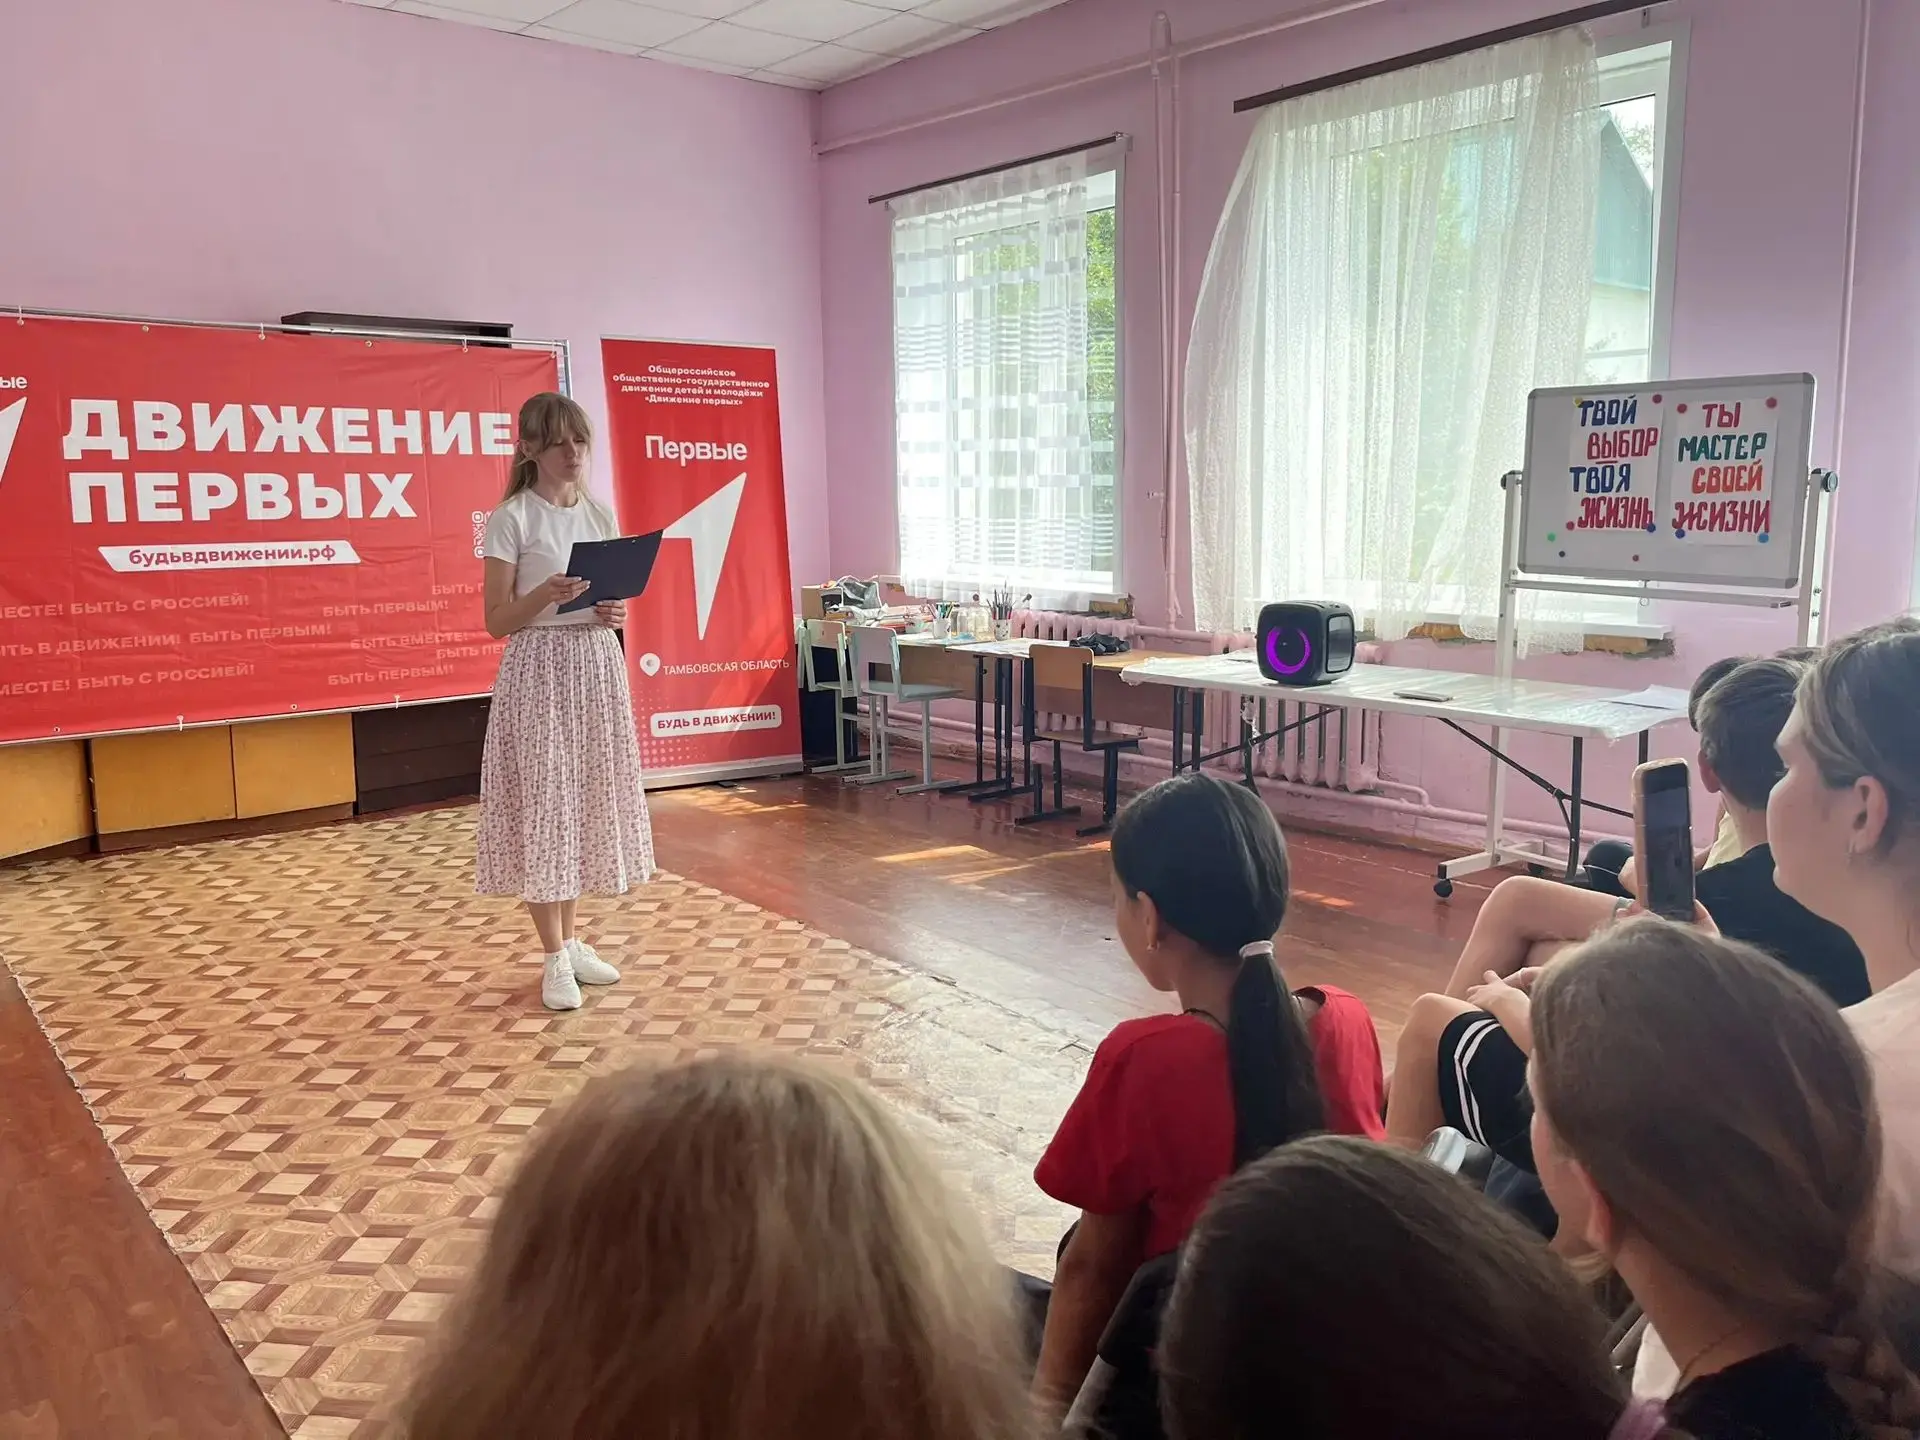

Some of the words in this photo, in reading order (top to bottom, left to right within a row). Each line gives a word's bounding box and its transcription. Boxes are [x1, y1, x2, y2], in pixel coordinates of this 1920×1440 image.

[0, 376, 27, 389] ые
[613, 373, 770, 389] общественно-государственное
[648, 365, 736, 377] Общероссийское
[621, 384, 672, 394] движение
[674, 385, 703, 395] детей
[713, 387, 763, 398] молодёжи
[645, 394, 700, 405] «Движение
[702, 397, 743, 406] первых»
[1578, 394, 1637, 427] ТВОЙ
[1702, 401, 1741, 428] ТЫ
[63, 398, 515, 460] ДВИЖЕНИЕ
[645, 435, 747, 467] Первые
[1587, 427, 1659, 460] ВЫБОР
[1678, 432, 1767, 462] МАСТЕР
[1569, 463, 1631, 493] ТВОЯ
[1692, 459, 1764, 494] СВОЕЙ
[69, 471, 418, 523] ПЕРВЫХ
[1577, 497, 1654, 529] ЖИЗНЬ
[1672, 500, 1771, 533] ЖИЗНИ
[129, 544, 337, 568] будьвдвижении.рф
[432, 583, 474, 595] БЫТЬ
[0, 603, 64, 619] ЕСТЕ!
[70, 601, 129, 615] БЫТЬ
[133, 599, 147, 612] С
[151, 592, 250, 610] РОССИЕЙ!
[323, 605, 371, 617] БЫТЬ
[374, 600, 449, 614] ПЕРВЫМ!
[38, 642, 52, 654] В
[56, 634, 182, 655] ДВИЖЕНИИ!
[190, 629, 243, 644] БЫТЬ
[247, 623, 332, 640] ПЕРВЫМ!
[351, 636, 397, 650] БЫТЬ
[400, 632, 469, 646] ВМЕСТЕ!
[436, 646, 479, 660] БЫТЬ
[663, 661, 738, 675] ТАМБОВСКАЯ
[740, 658, 790, 671] ОБЛАСТЬ
[78, 675, 135, 690] БЫТЬ
[139, 671, 152, 684] С
[157, 663, 255, 683] РОССИЕЙ!
[328, 673, 375, 686] БЫТЬ
[378, 665, 454, 682] ПЕРВЫМ!
[657, 717, 690, 729] БУДЬ
[692, 717, 701, 726] В
[703, 711, 776, 727] ДВИЖЕНИИ!
